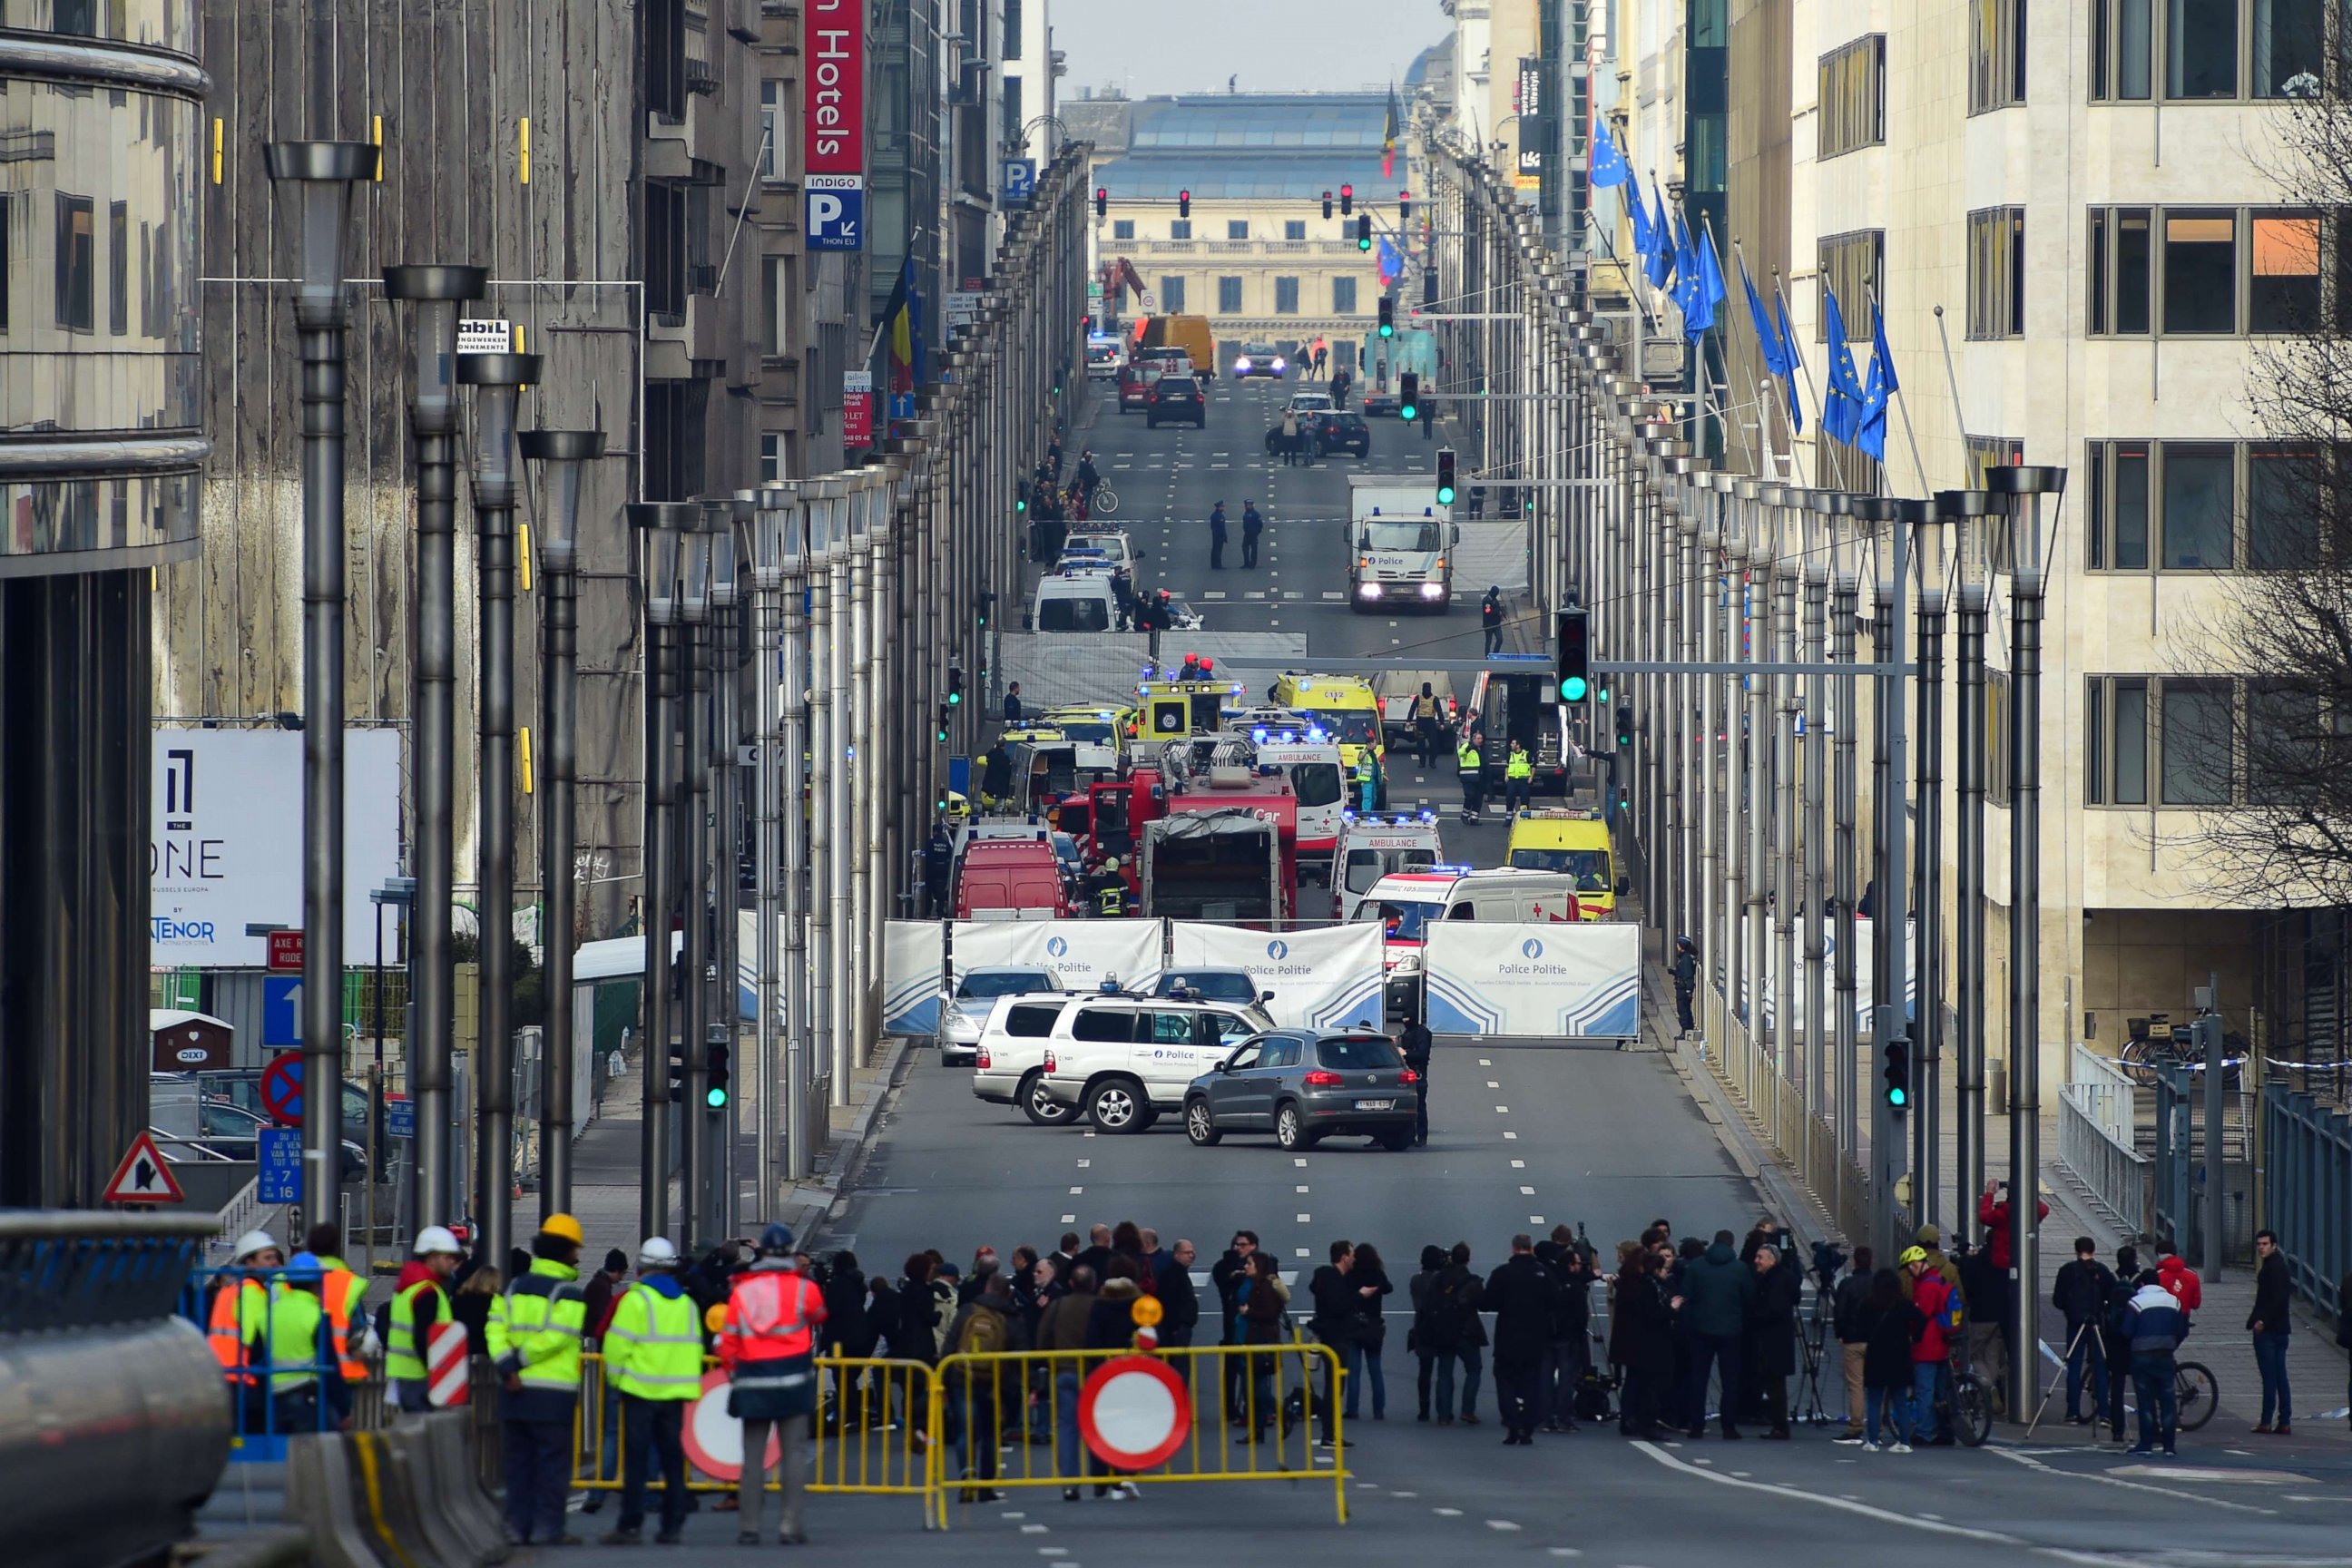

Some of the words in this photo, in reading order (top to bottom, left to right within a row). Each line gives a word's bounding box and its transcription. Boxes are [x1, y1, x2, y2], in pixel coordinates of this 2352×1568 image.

[817, 30, 849, 155] Hotels
[1520, 71, 1530, 116] workspace
[1530, 71, 1540, 106] lifestyle
[1007, 163, 1026, 189] P
[811, 178, 855, 188] INDIGO
[809, 193, 842, 236] P
[822, 238, 843, 246] THON
[845, 238, 855, 246] EU
[849, 412, 864, 420] LET
[1378, 556, 1404, 565] Police
[1278, 753, 1321, 761] AMBULANCE
[1253, 808, 1280, 823] Car
[1539, 810, 1582, 818] AMBULANCE
[1368, 839, 1417, 848] AMBULANCE
[151, 840, 224, 878] NE
[151, 916, 214, 944] TENOR
[274, 937, 292, 948] AXE
[279, 953, 302, 963] RODE
[1058, 962, 1092, 973] Politie
[1243, 965, 1274, 975] Police
[1278, 965, 1311, 975] Politie
[1499, 964, 1529, 975] Police
[1533, 964, 1567, 975] Politie
[1166, 1050, 1194, 1059] Police
[279, 1132, 289, 1141] DU
[273, 1142, 282, 1150] AU
[287, 1142, 301, 1150] VEN
[271, 1150, 284, 1158] VAN
[289, 1150, 300, 1158] MA
[273, 1158, 286, 1167] TOT
[290, 1158, 301, 1167] VR
[281, 1171, 290, 1183] 7
[279, 1186, 295, 1199] 16
